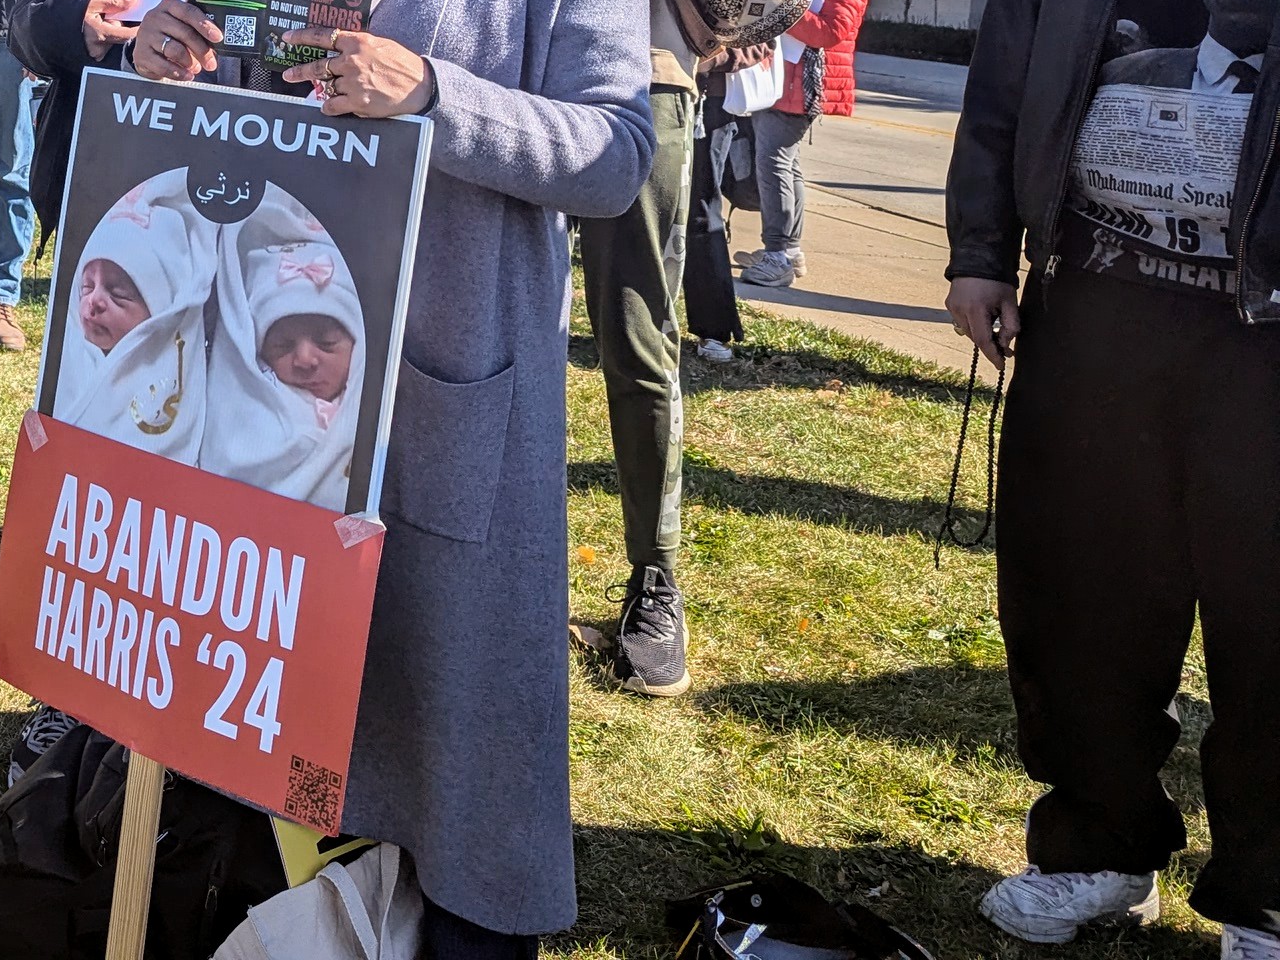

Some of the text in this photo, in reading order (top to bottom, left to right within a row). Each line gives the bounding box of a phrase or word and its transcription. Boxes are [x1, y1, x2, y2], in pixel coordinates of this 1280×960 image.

[269, 16, 278, 25] DO
[278, 17, 291, 28] NOT
[271, 0, 279, 10] DO
[280, 2, 292, 13] NOT
[293, 4, 308, 16] VOTE
[309, 2, 362, 31] HARRIS
[112, 93, 379, 167] WE MOURN
[1086, 169, 1174, 201] Muhammad
[1165, 216, 1201, 254] IS
[45, 473, 306, 651] ABANDON
[34, 565, 180, 710] HARRIS
